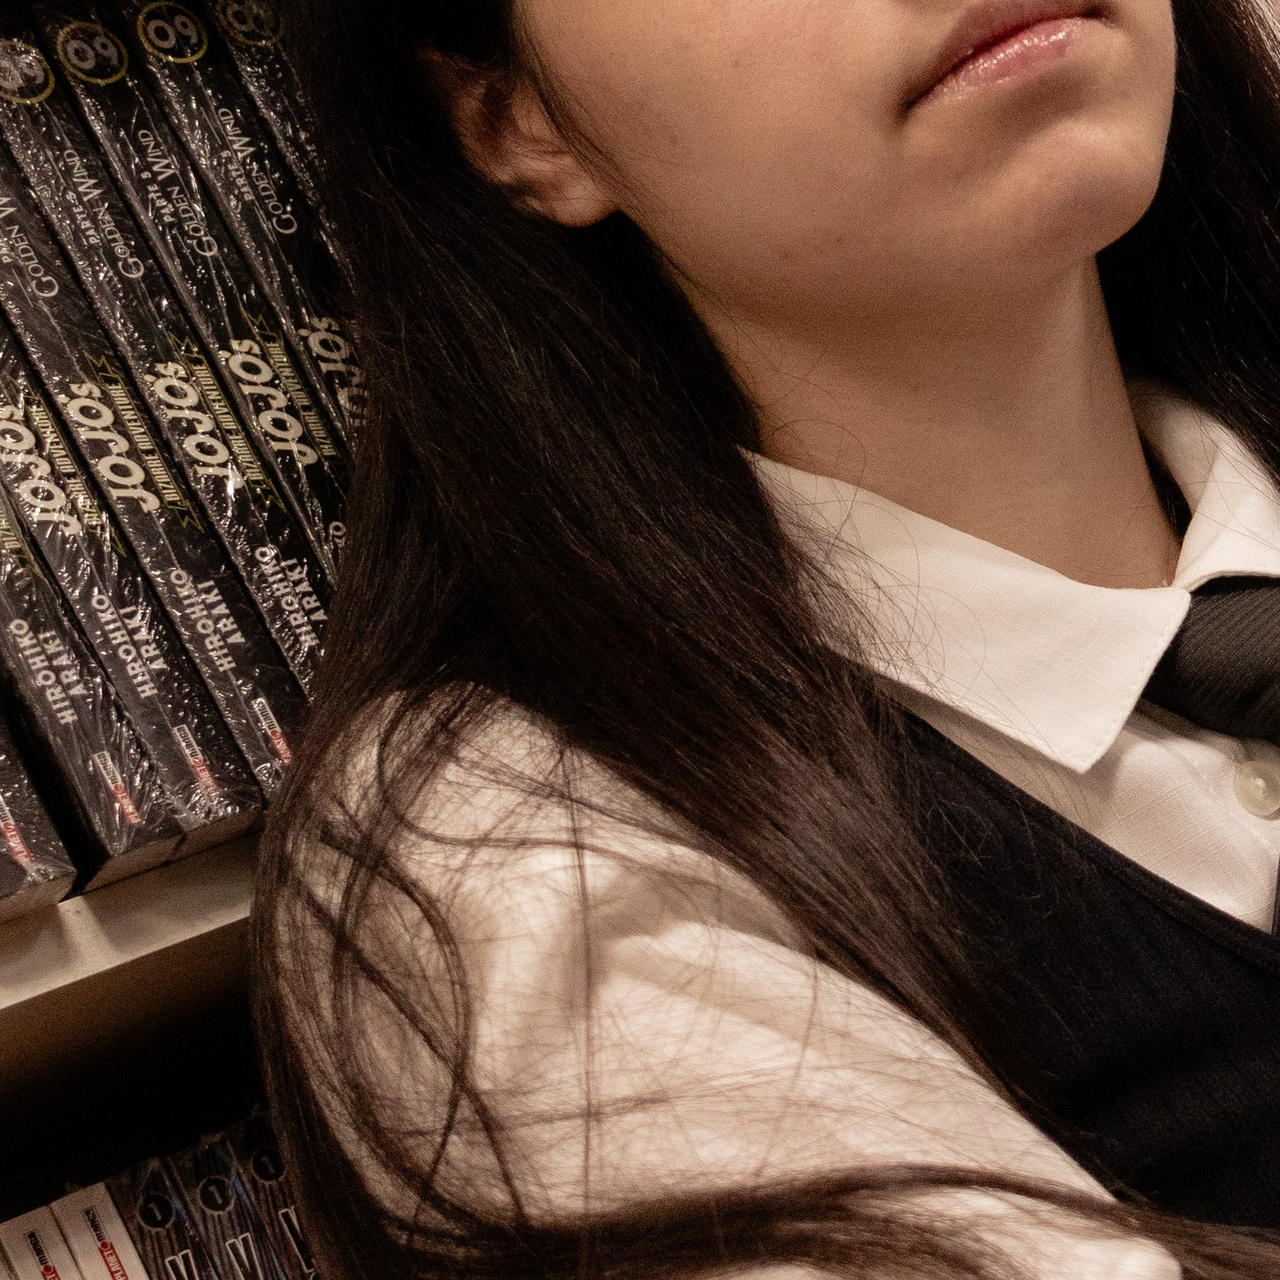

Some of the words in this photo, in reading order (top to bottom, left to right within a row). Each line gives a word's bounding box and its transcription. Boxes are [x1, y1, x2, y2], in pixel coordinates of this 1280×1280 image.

[67, 34, 120, 70] 09
[150, 14, 198, 49] 09
[138, 129, 176, 181] WIND
[217, 107, 257, 158] WIND
[64, 149, 103, 202] WIND
[245, 161, 298, 235] GOLDEN
[165, 185, 219, 257] GOLDEN
[6, 225, 59, 298] GOLDEN
[91, 593, 158, 700] HIROHIKO
[117, 604, 169, 672] ARAKI
[170, 567, 237, 673] HIROHIKO
[197, 579, 247, 646] ARAKI
[10, 619, 79, 726] HIROHIKO
[38, 628, 88, 698] ARAKI
[207, 1186, 223, 1206] 1
